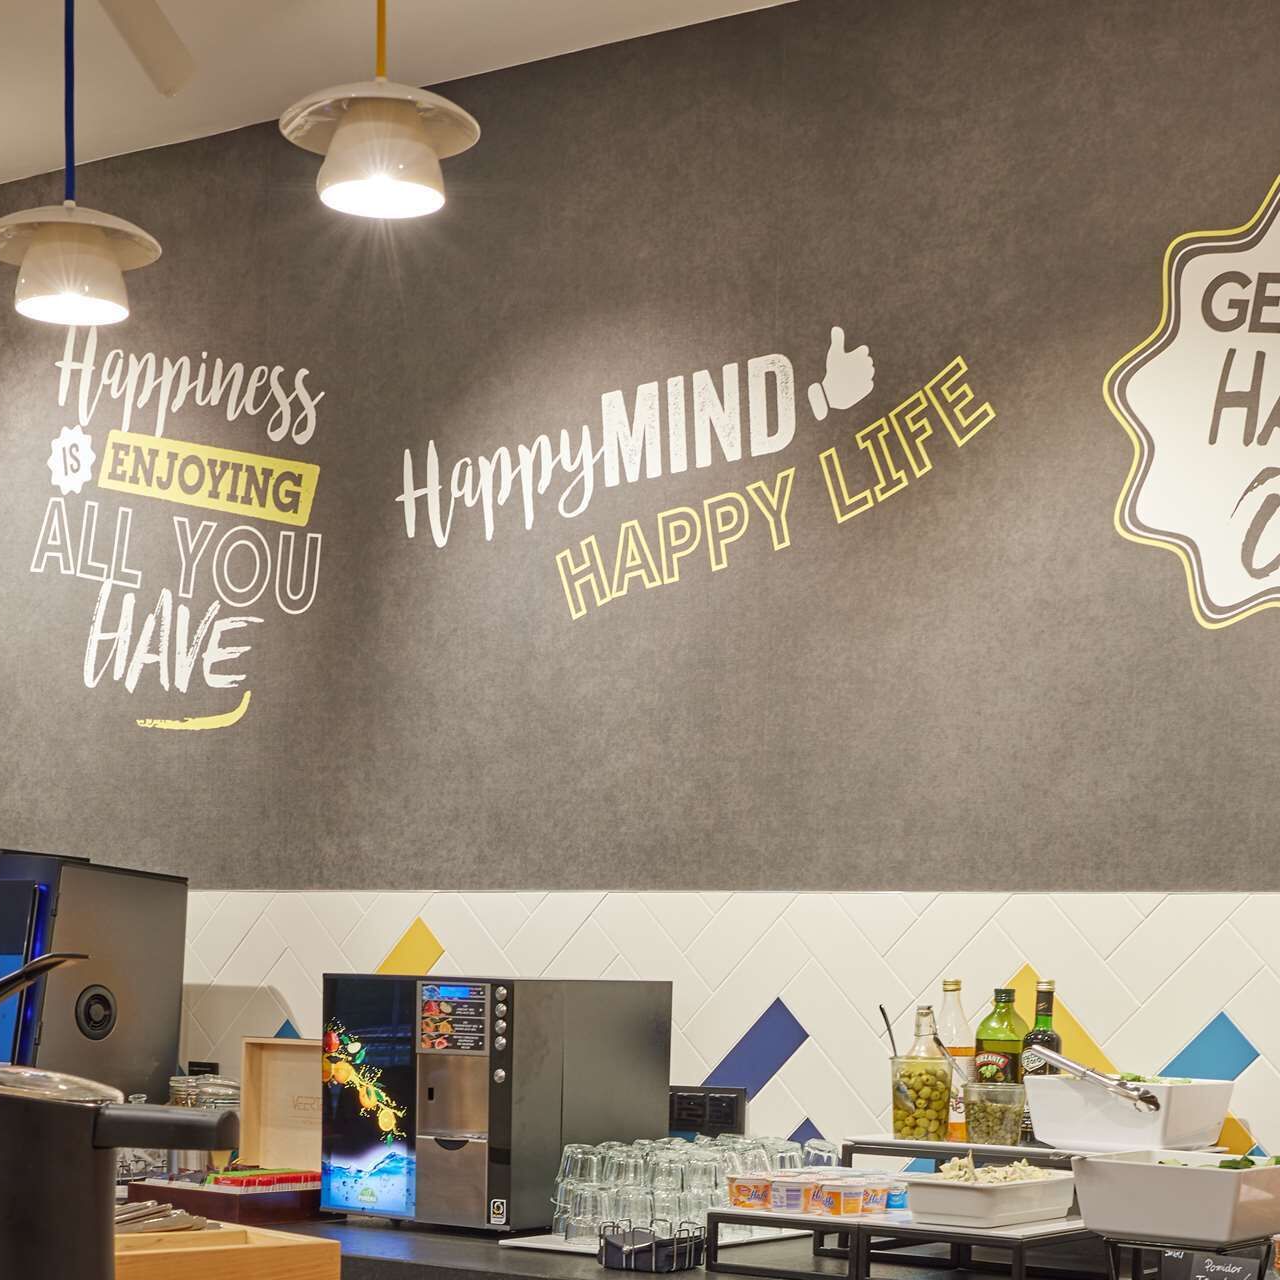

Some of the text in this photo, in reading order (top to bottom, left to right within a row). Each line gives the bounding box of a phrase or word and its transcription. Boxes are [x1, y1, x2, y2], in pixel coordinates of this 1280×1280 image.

[54, 327, 325, 445] Happiness
[62, 442, 304, 515] IS ENJOYING
[555, 355, 996, 620] HAPPY LIFE
[30, 497, 322, 615] ALL YOU
[84, 578, 264, 693] HAVE
[1205, 1259, 1243, 1273] Pomidor
